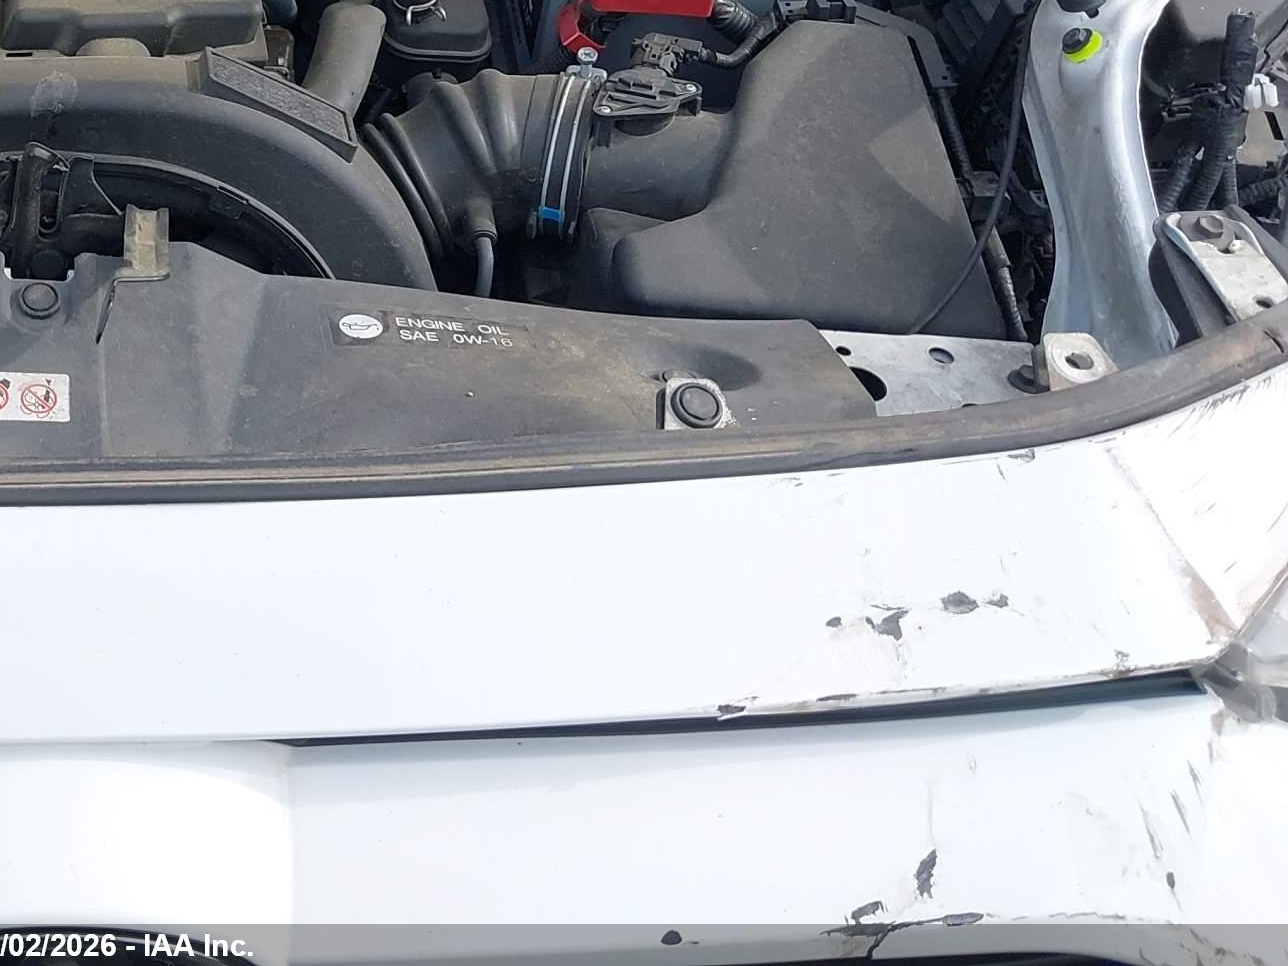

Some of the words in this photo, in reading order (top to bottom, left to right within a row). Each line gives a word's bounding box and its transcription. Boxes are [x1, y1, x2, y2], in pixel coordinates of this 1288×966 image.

[395, 317, 466, 332] ENGINE
[478, 324, 510, 336] OIL
[399, 329, 440, 342] SAE
[453, 333, 513, 347] 0W-16
